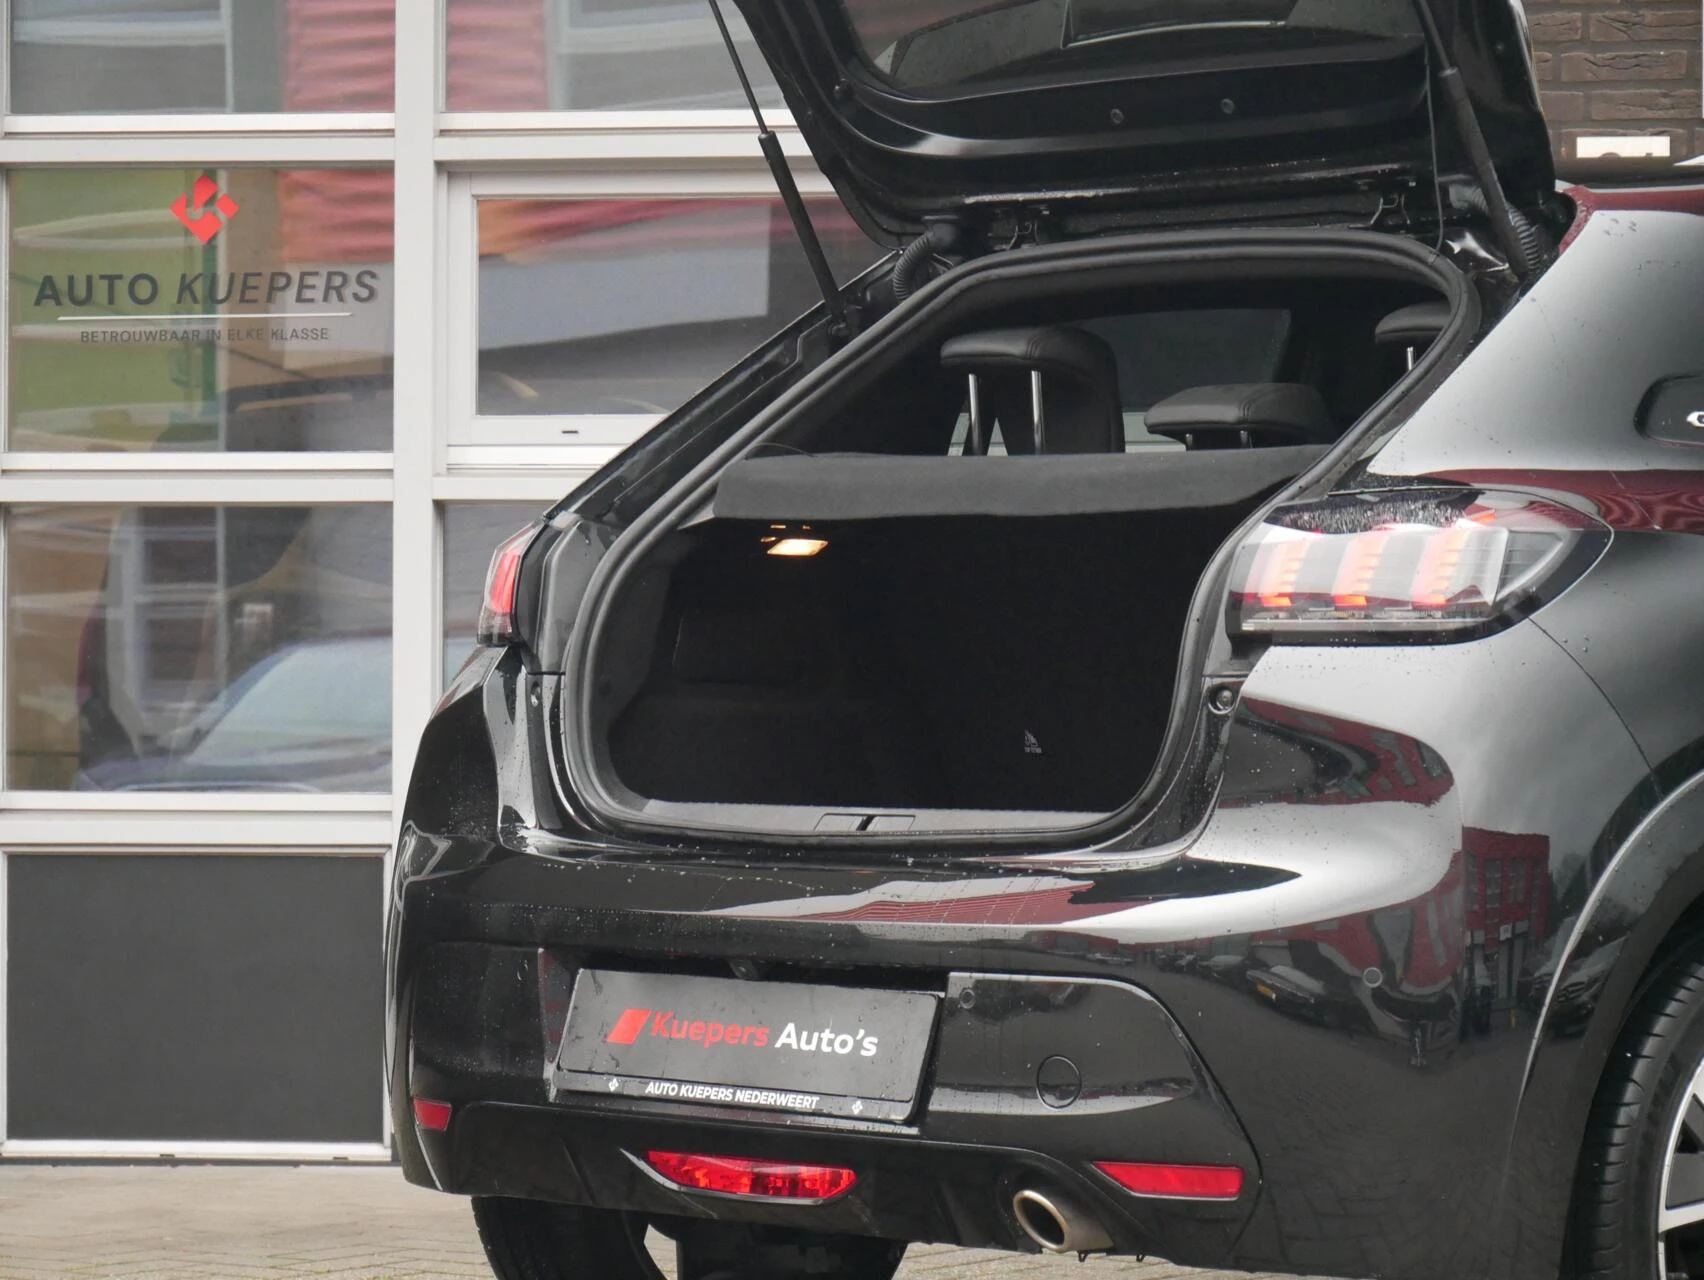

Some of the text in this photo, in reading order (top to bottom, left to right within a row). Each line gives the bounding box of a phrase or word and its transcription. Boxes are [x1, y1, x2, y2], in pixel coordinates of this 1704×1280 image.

[33, 269, 381, 307] AUTO KUEPERS
[80, 327, 329, 344] BETROUWBAAR IN ELKE KLASSE
[651, 1010, 879, 1057] Kuepers Auto's
[645, 1081, 820, 1109] AUTO KUEPERS NEDERWEERT
